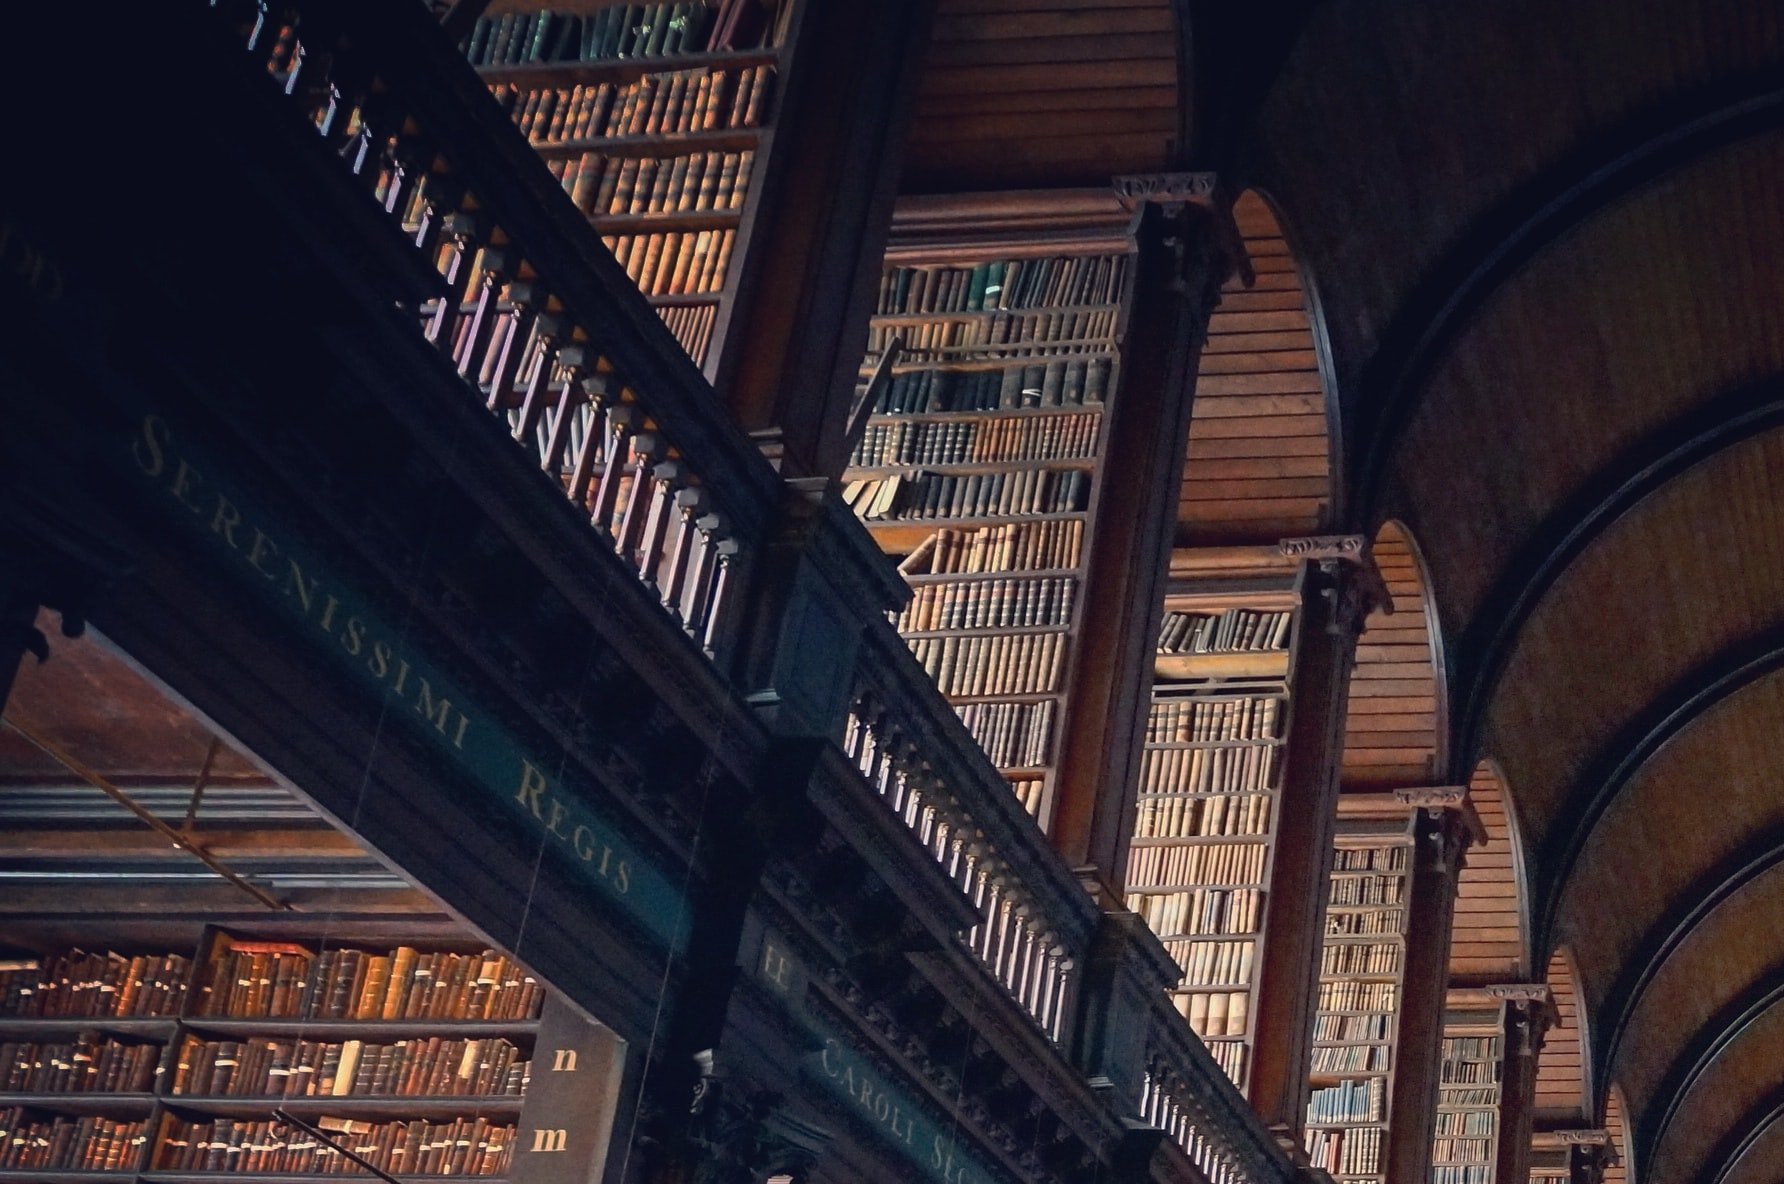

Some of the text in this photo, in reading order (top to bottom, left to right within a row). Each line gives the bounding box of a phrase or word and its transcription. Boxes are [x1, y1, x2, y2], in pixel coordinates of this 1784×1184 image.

[131, 414, 632, 896] SERENISSIMI REGIS
[552, 1050, 576, 1071] n
[821, 1037, 914, 1145] CAROLI
[531, 1130, 566, 1151] m
